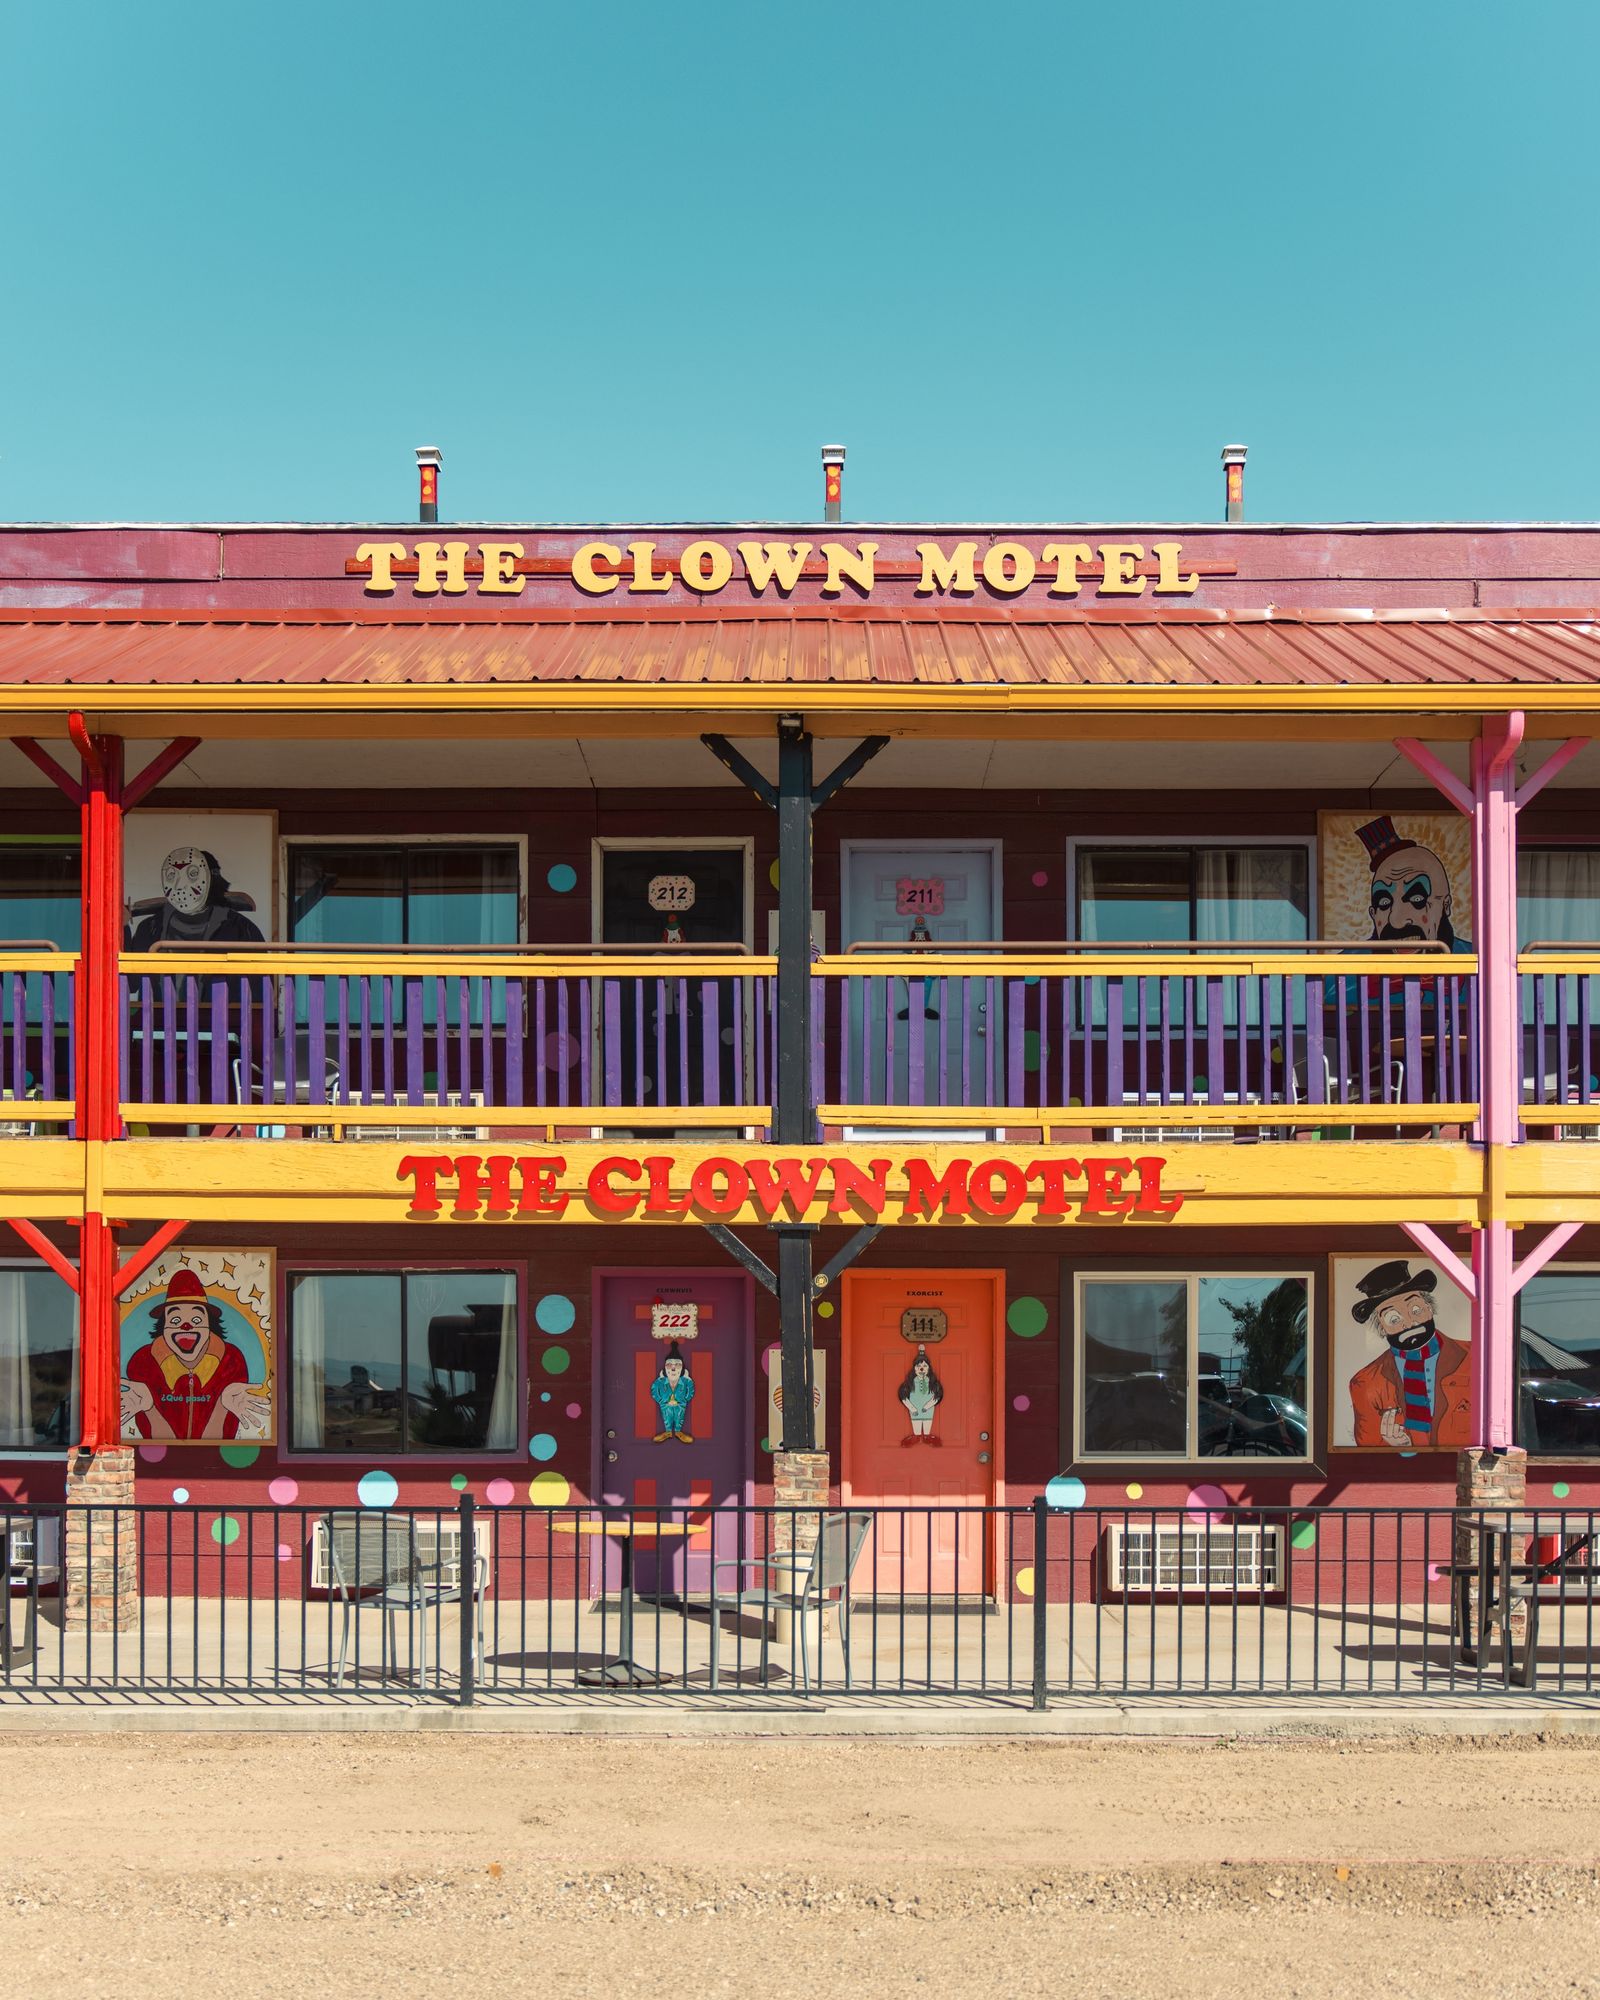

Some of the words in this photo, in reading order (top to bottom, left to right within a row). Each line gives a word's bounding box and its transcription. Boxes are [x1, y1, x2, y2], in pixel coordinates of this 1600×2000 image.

[355, 542, 526, 592] THE
[571, 541, 879, 592] CLOWN
[916, 542, 1199, 592] MOTEL
[657, 886, 687, 900] 212
[906, 888, 933, 903] 211
[398, 1155, 570, 1213] THE
[588, 1156, 893, 1213] CLOWN
[904, 1157, 1184, 1215] MOTEL
[659, 1314, 691, 1328] 222
[911, 1318, 934, 1332] 111
[161, 1394, 184, 1402] ¿Qué
